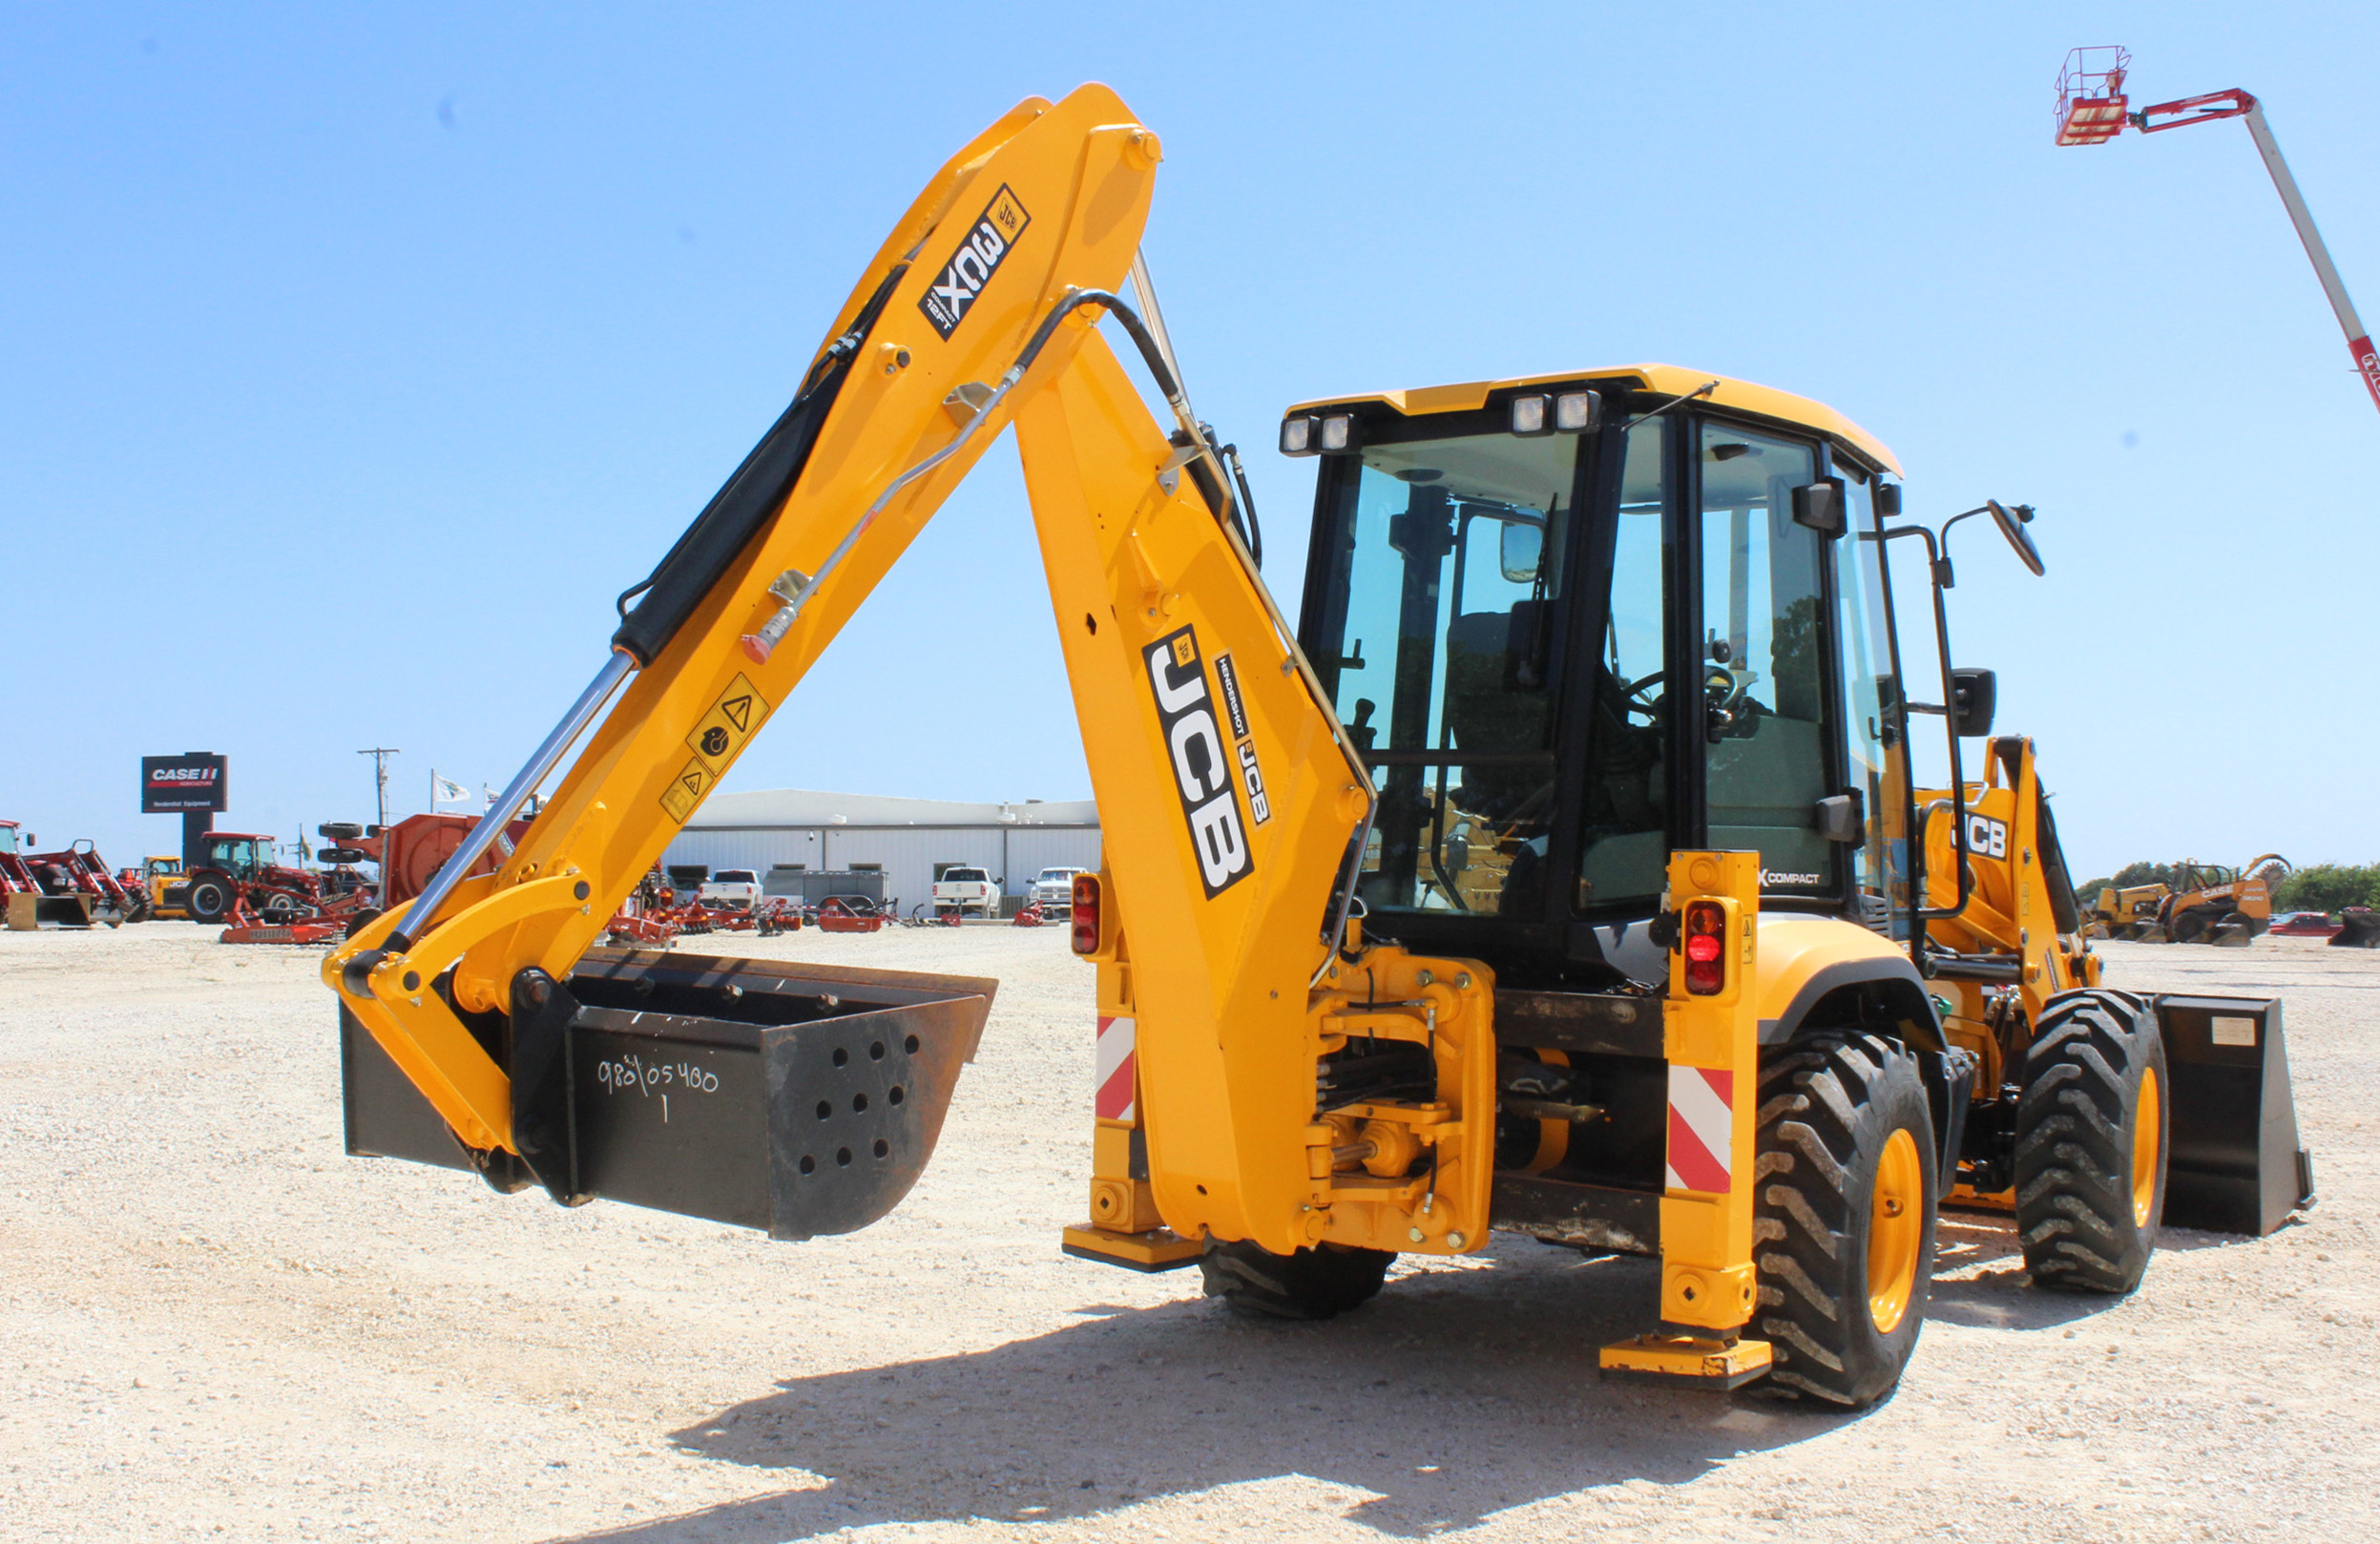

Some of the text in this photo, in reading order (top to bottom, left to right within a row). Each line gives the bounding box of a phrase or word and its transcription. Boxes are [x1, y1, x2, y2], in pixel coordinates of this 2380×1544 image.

[998, 203, 1017, 230] JCB
[927, 298, 952, 330] 12FT
[930, 291, 956, 323] COMPACT
[1219, 657, 1245, 735] HENDERSHOT
[153, 768, 200, 781] CASE
[1151, 644, 1245, 887] JCB
[1240, 746, 1270, 824] JCB
[1767, 872, 1820, 885] COMPACT
[2202, 885, 2234, 898] CASE
